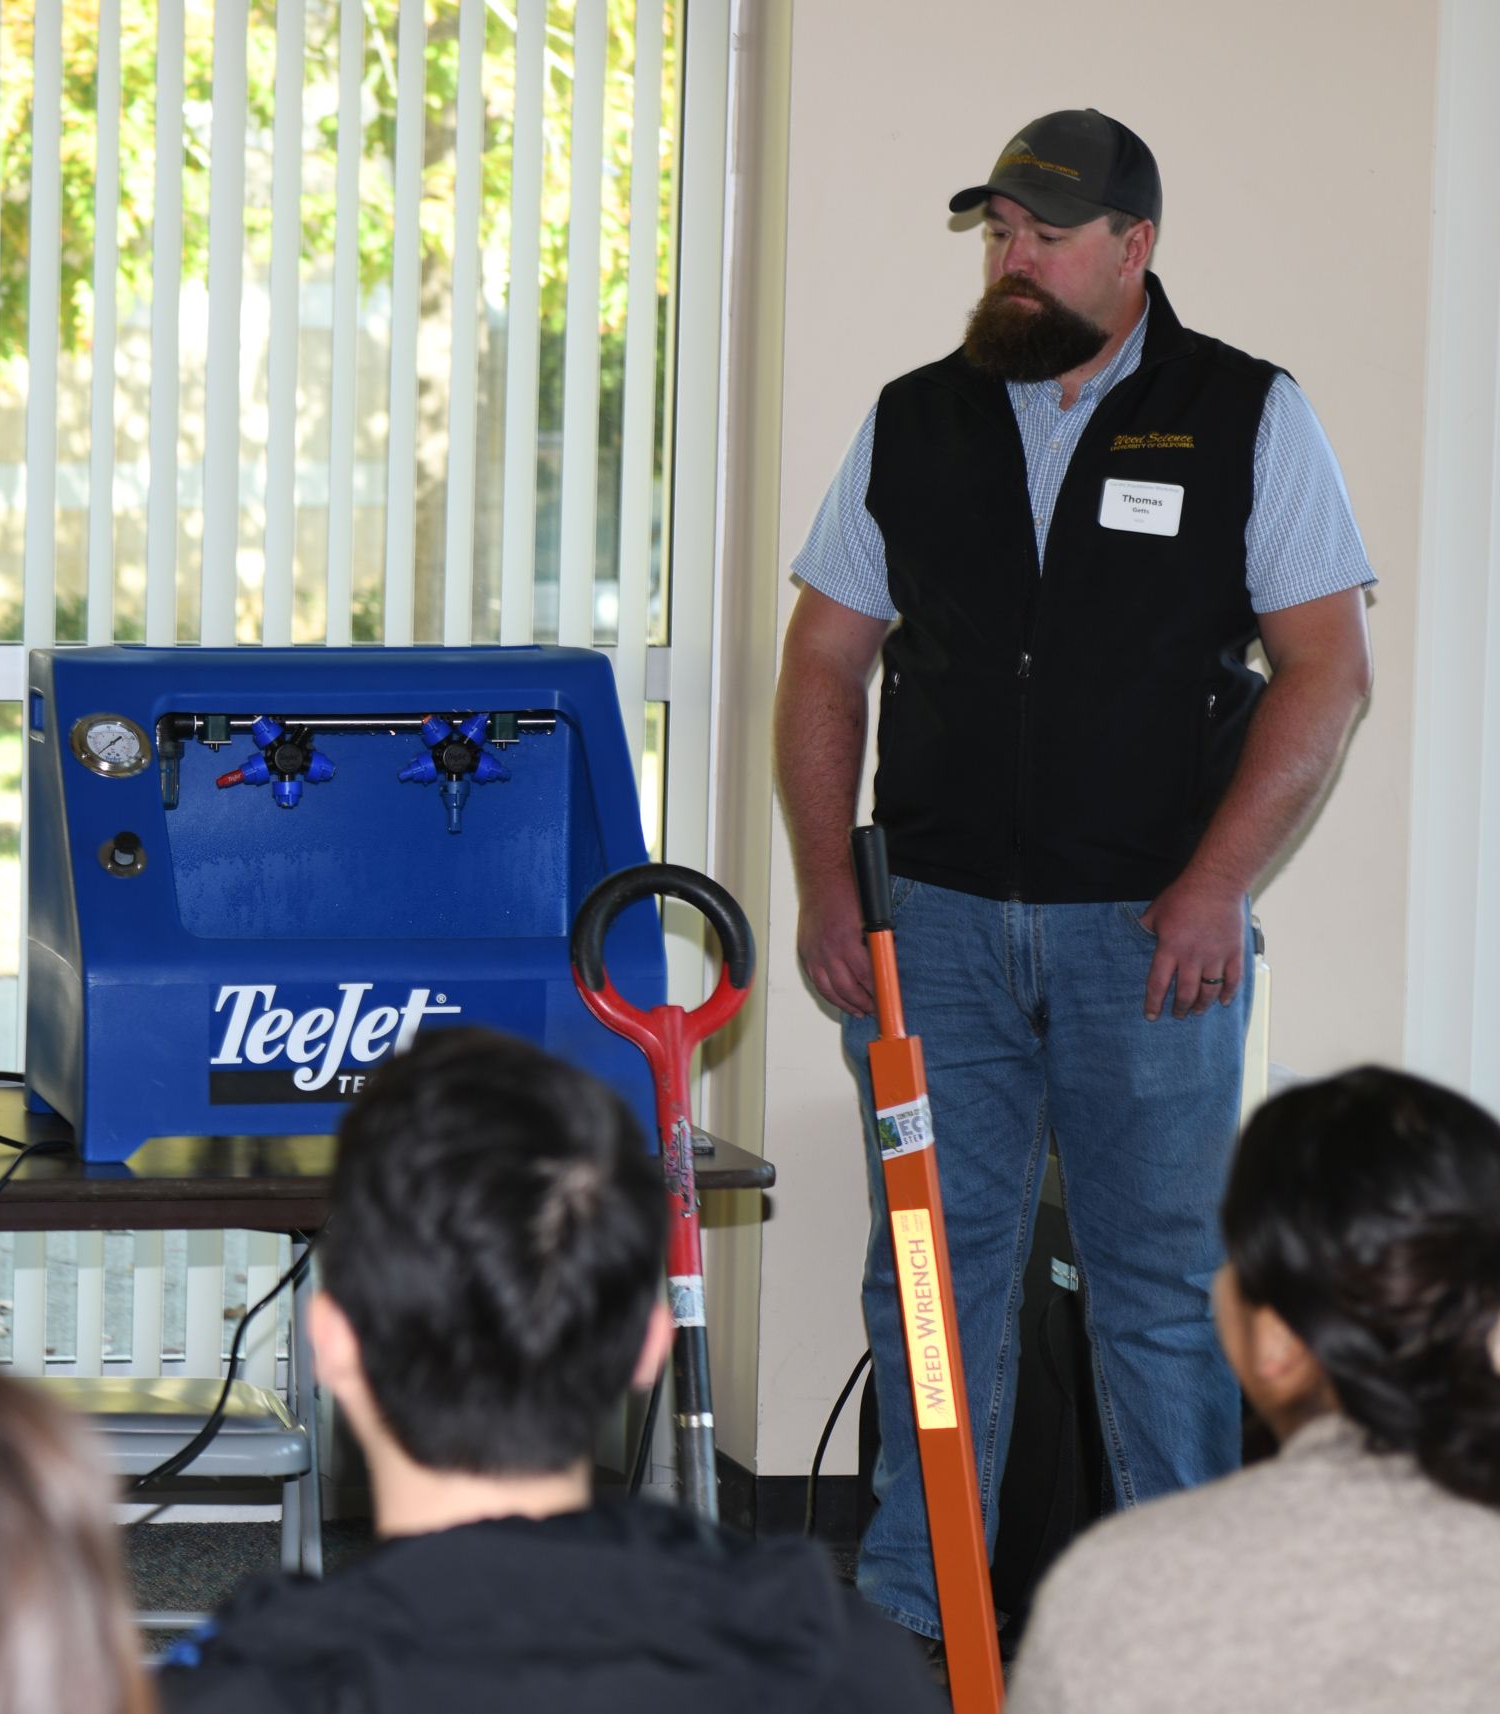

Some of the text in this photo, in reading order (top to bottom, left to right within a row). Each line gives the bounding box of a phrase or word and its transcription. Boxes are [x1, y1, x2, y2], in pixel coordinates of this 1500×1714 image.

[1147, 431, 1194, 444] Science
[1122, 494, 1164, 507] Thomas
[210, 983, 462, 1092] TeeJet
[908, 1238, 938, 1340] WRENCH
[916, 1344, 948, 1410] WEED
